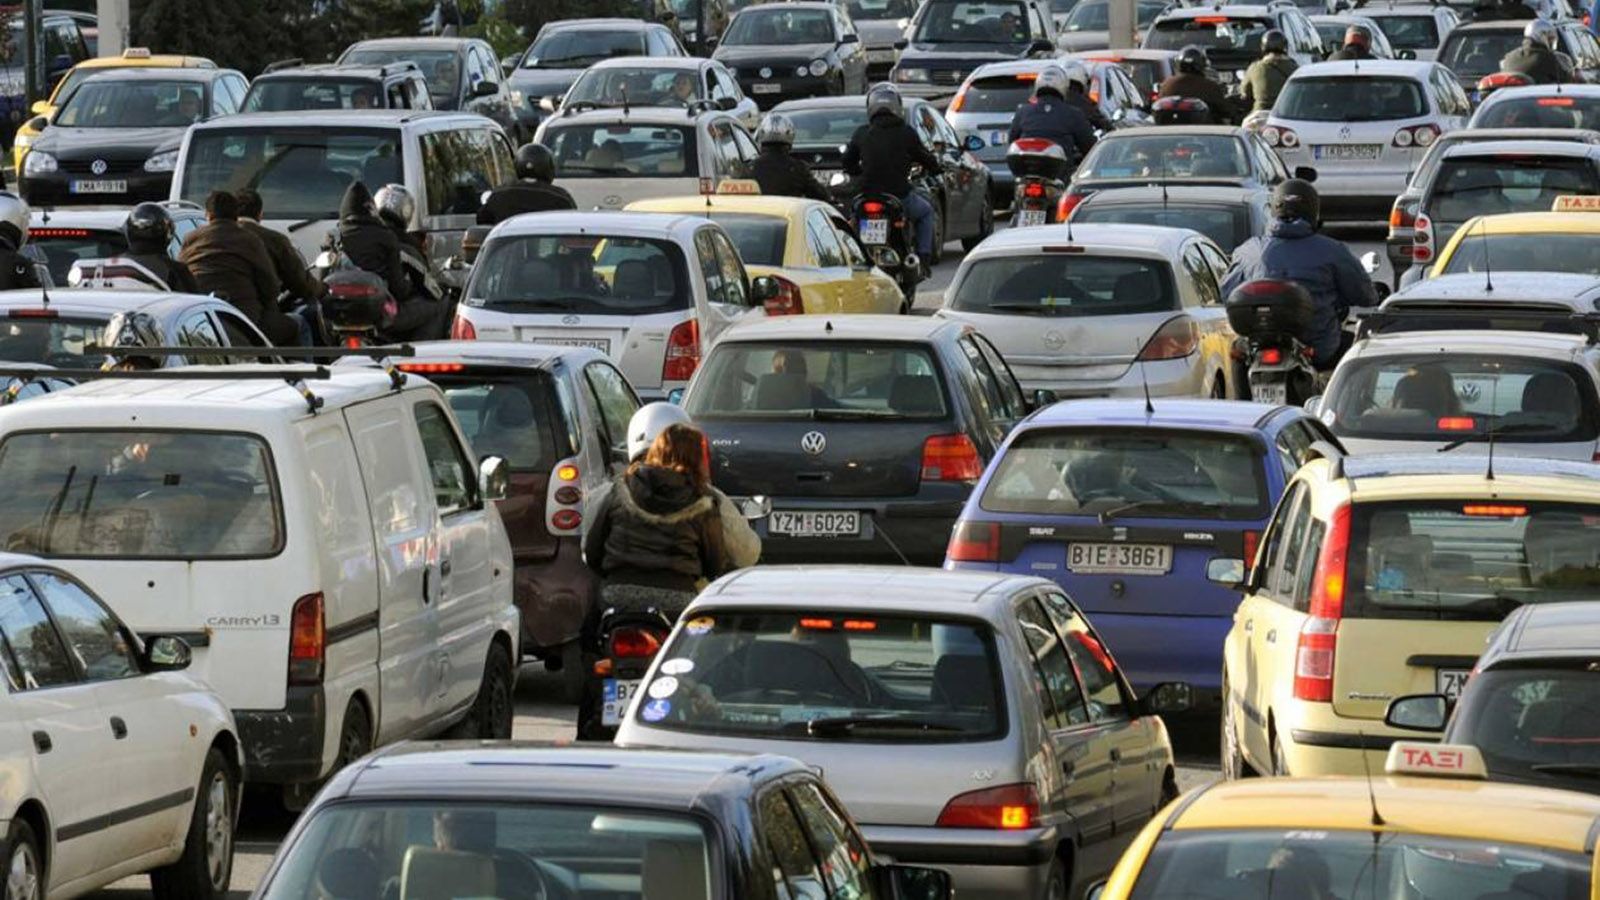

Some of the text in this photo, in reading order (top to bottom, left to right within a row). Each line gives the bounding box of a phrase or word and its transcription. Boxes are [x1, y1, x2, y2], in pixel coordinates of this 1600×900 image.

[773, 511, 856, 532] YZM 6029
[1072, 546, 1164, 567] BIE 3861
